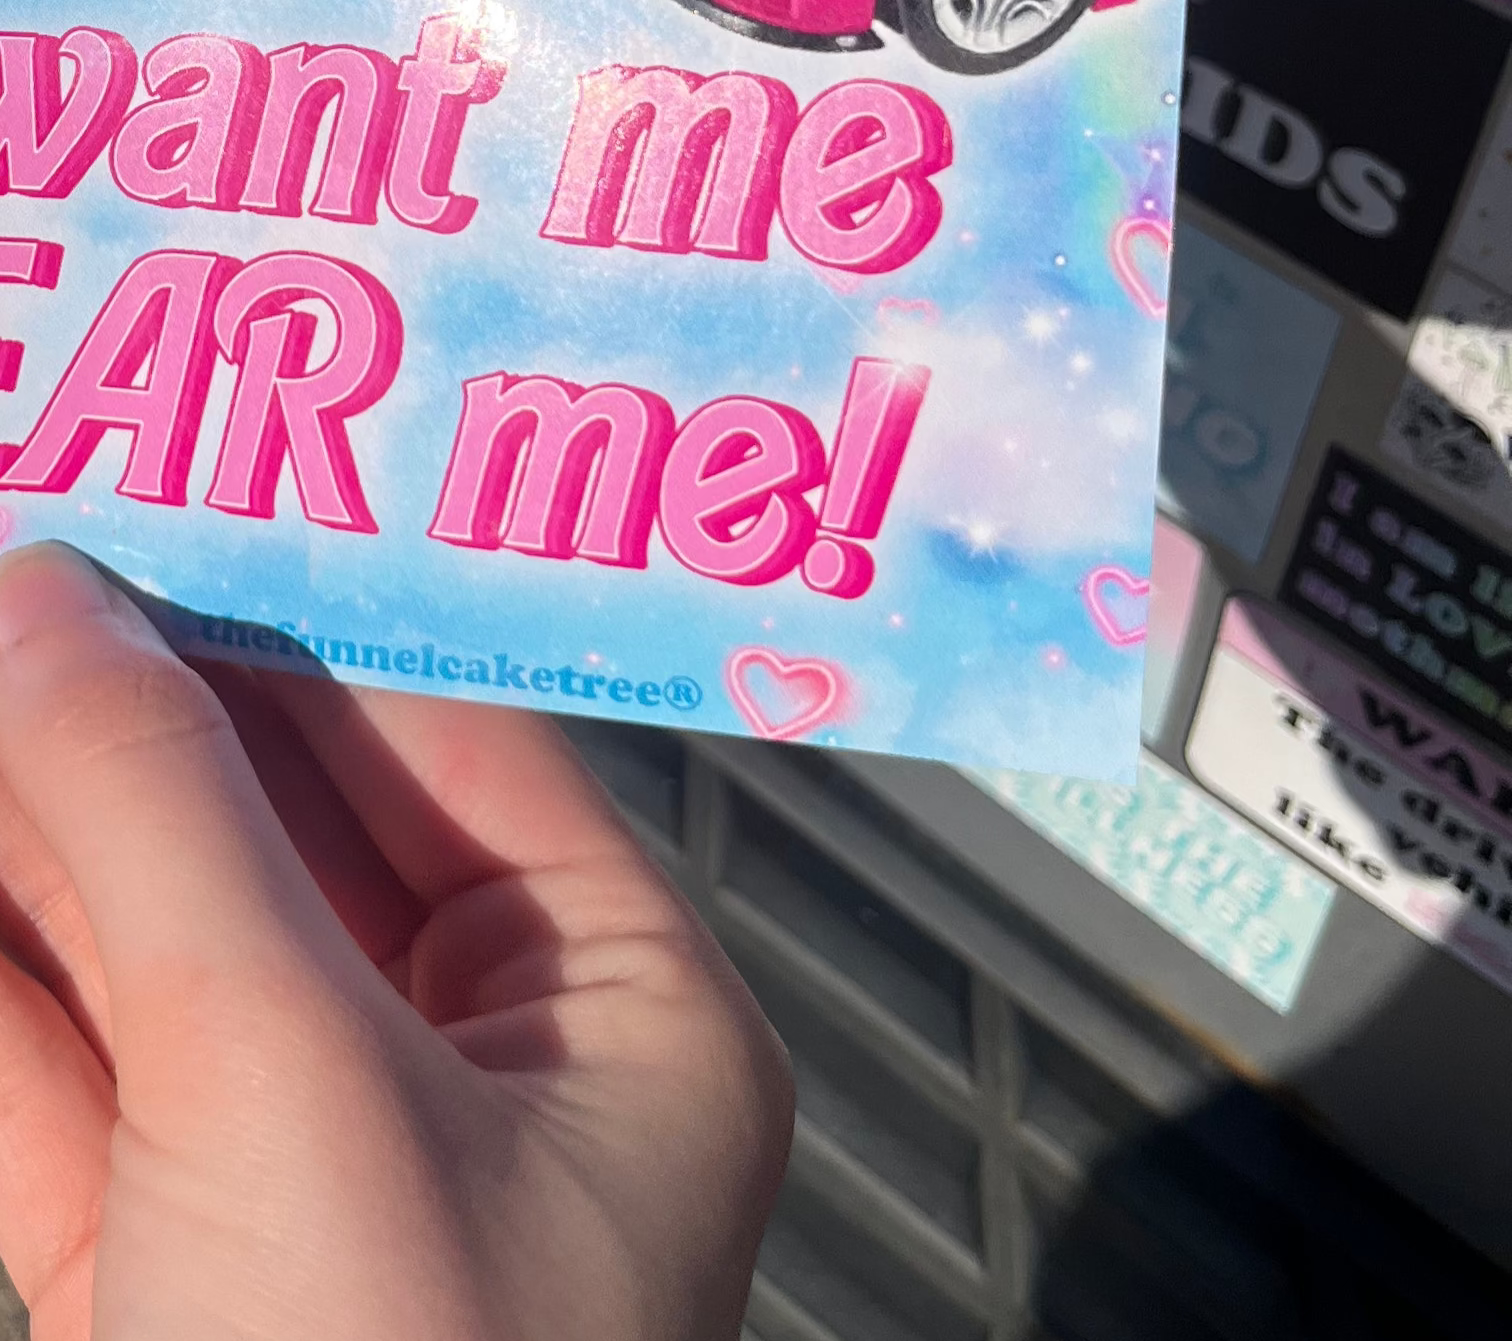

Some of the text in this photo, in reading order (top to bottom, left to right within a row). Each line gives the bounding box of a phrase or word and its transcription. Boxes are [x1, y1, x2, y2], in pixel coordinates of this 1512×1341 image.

[539, 62, 954, 275] me
[427, 356, 933, 600] me!
[1275, 693, 1384, 788] The
